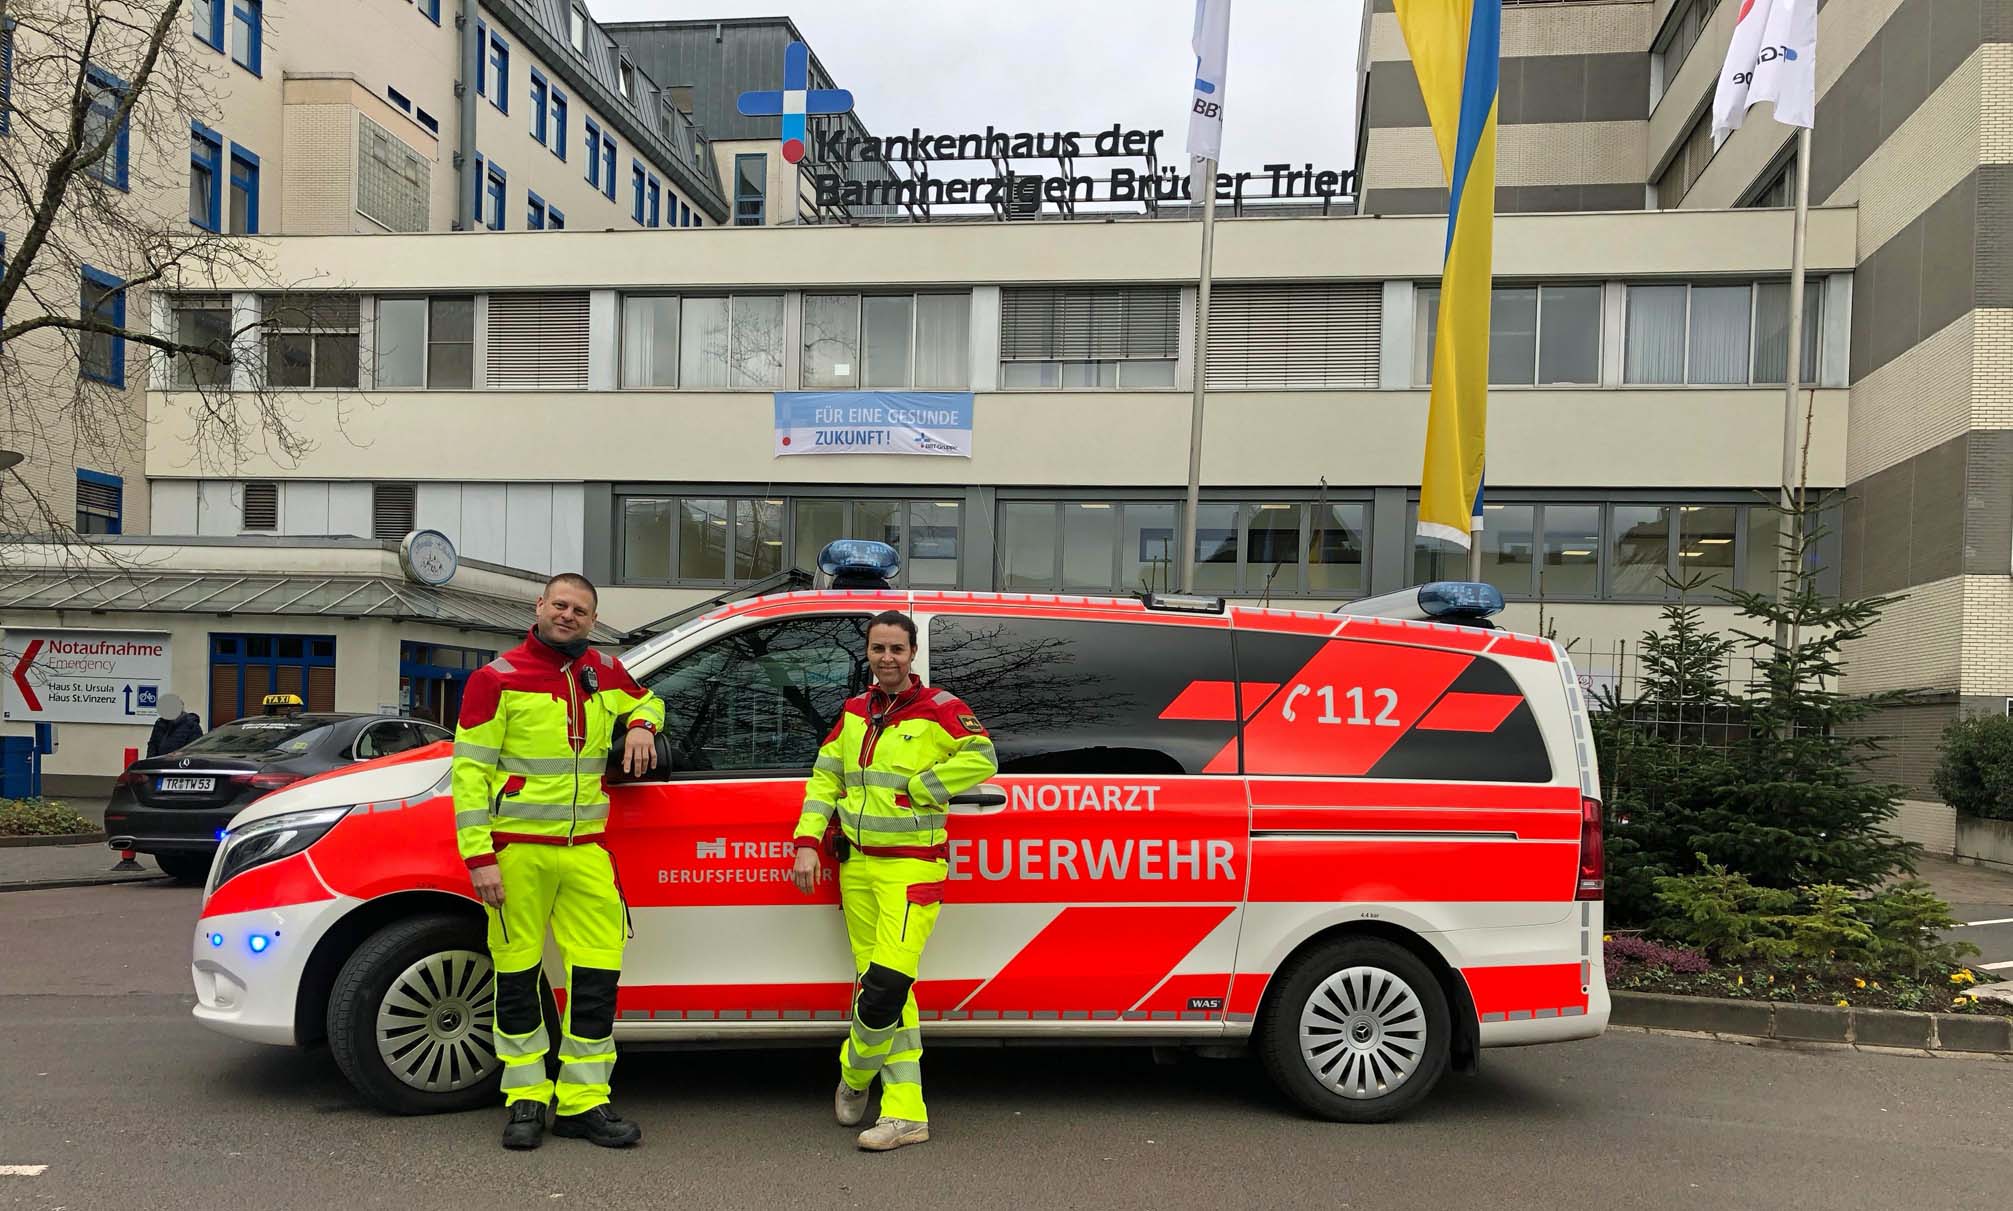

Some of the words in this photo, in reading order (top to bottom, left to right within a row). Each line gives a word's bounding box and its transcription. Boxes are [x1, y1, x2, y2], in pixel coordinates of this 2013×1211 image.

[818, 126, 1081, 161] Krankenhaus
[1094, 123, 1164, 156] der
[816, 170, 1094, 213] Barmherzigen
[1264, 163, 1358, 198] Trier
[815, 405, 843, 424] FÜR
[848, 408, 883, 424] EINE
[887, 408, 960, 426] GESUNDE
[49, 639, 163, 656] Notaufnahme
[49, 656, 116, 673] Emergency
[49, 682, 71, 692] Haus
[72, 683, 83, 692] St.
[85, 684, 115, 693] Ursula
[48, 693, 71, 703] Haus
[267, 694, 290, 704] TAXI
[1317, 685, 1401, 727] 112
[166, 779, 179, 790] TR
[198, 779, 211, 790] 53
[1011, 784, 1161, 812] NOTARZT
[730, 841, 798, 858] TRIER
[948, 838, 1237, 881] EUERWEHR
[658, 868, 833, 884] BERUFSFEUERWR
